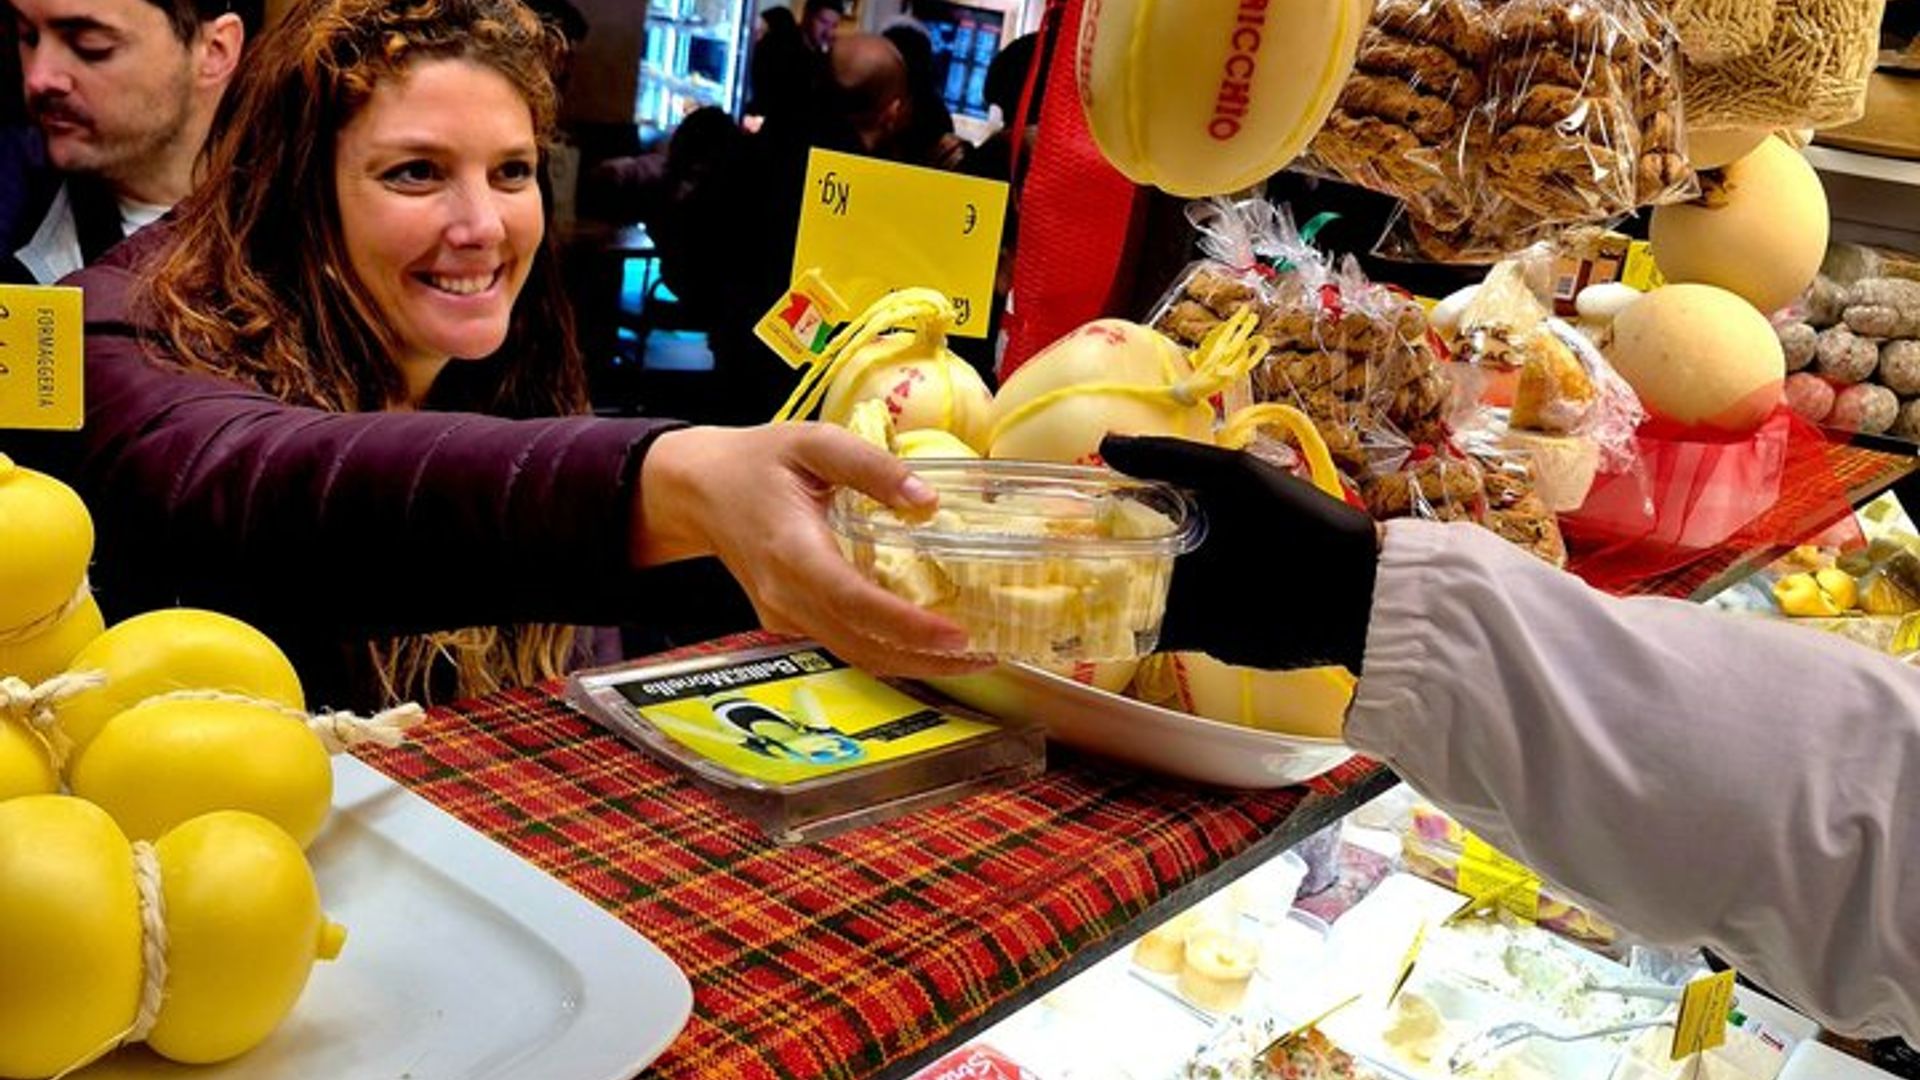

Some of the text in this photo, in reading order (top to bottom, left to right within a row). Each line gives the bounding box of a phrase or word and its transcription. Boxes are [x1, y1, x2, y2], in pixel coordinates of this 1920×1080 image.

[818, 171, 977, 235] € Kg.
[37, 307, 55, 408] FORMAGGERIA
